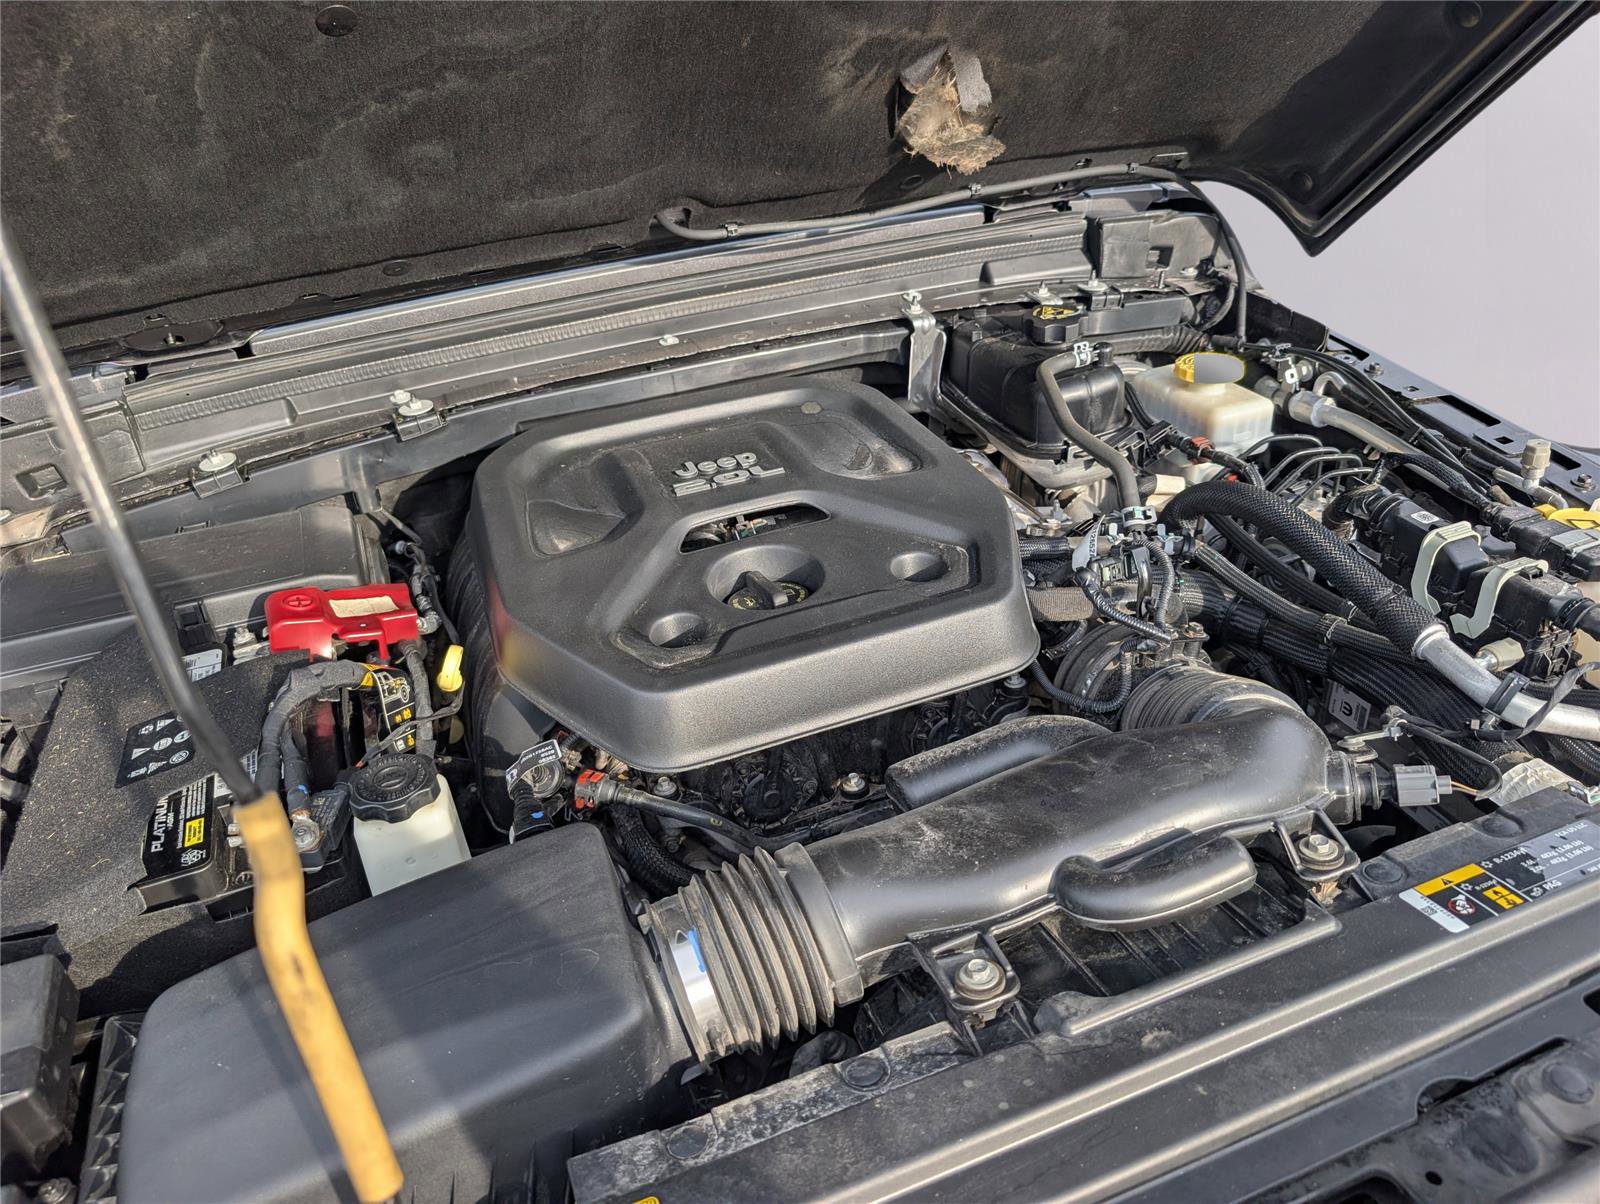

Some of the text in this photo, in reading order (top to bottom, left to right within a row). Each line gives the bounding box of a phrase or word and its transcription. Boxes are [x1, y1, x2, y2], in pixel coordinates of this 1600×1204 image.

[674, 452, 757, 478] Jeep
[673, 465, 786, 496] 2.0L
[1542, 879, 1562, 891] PAG
